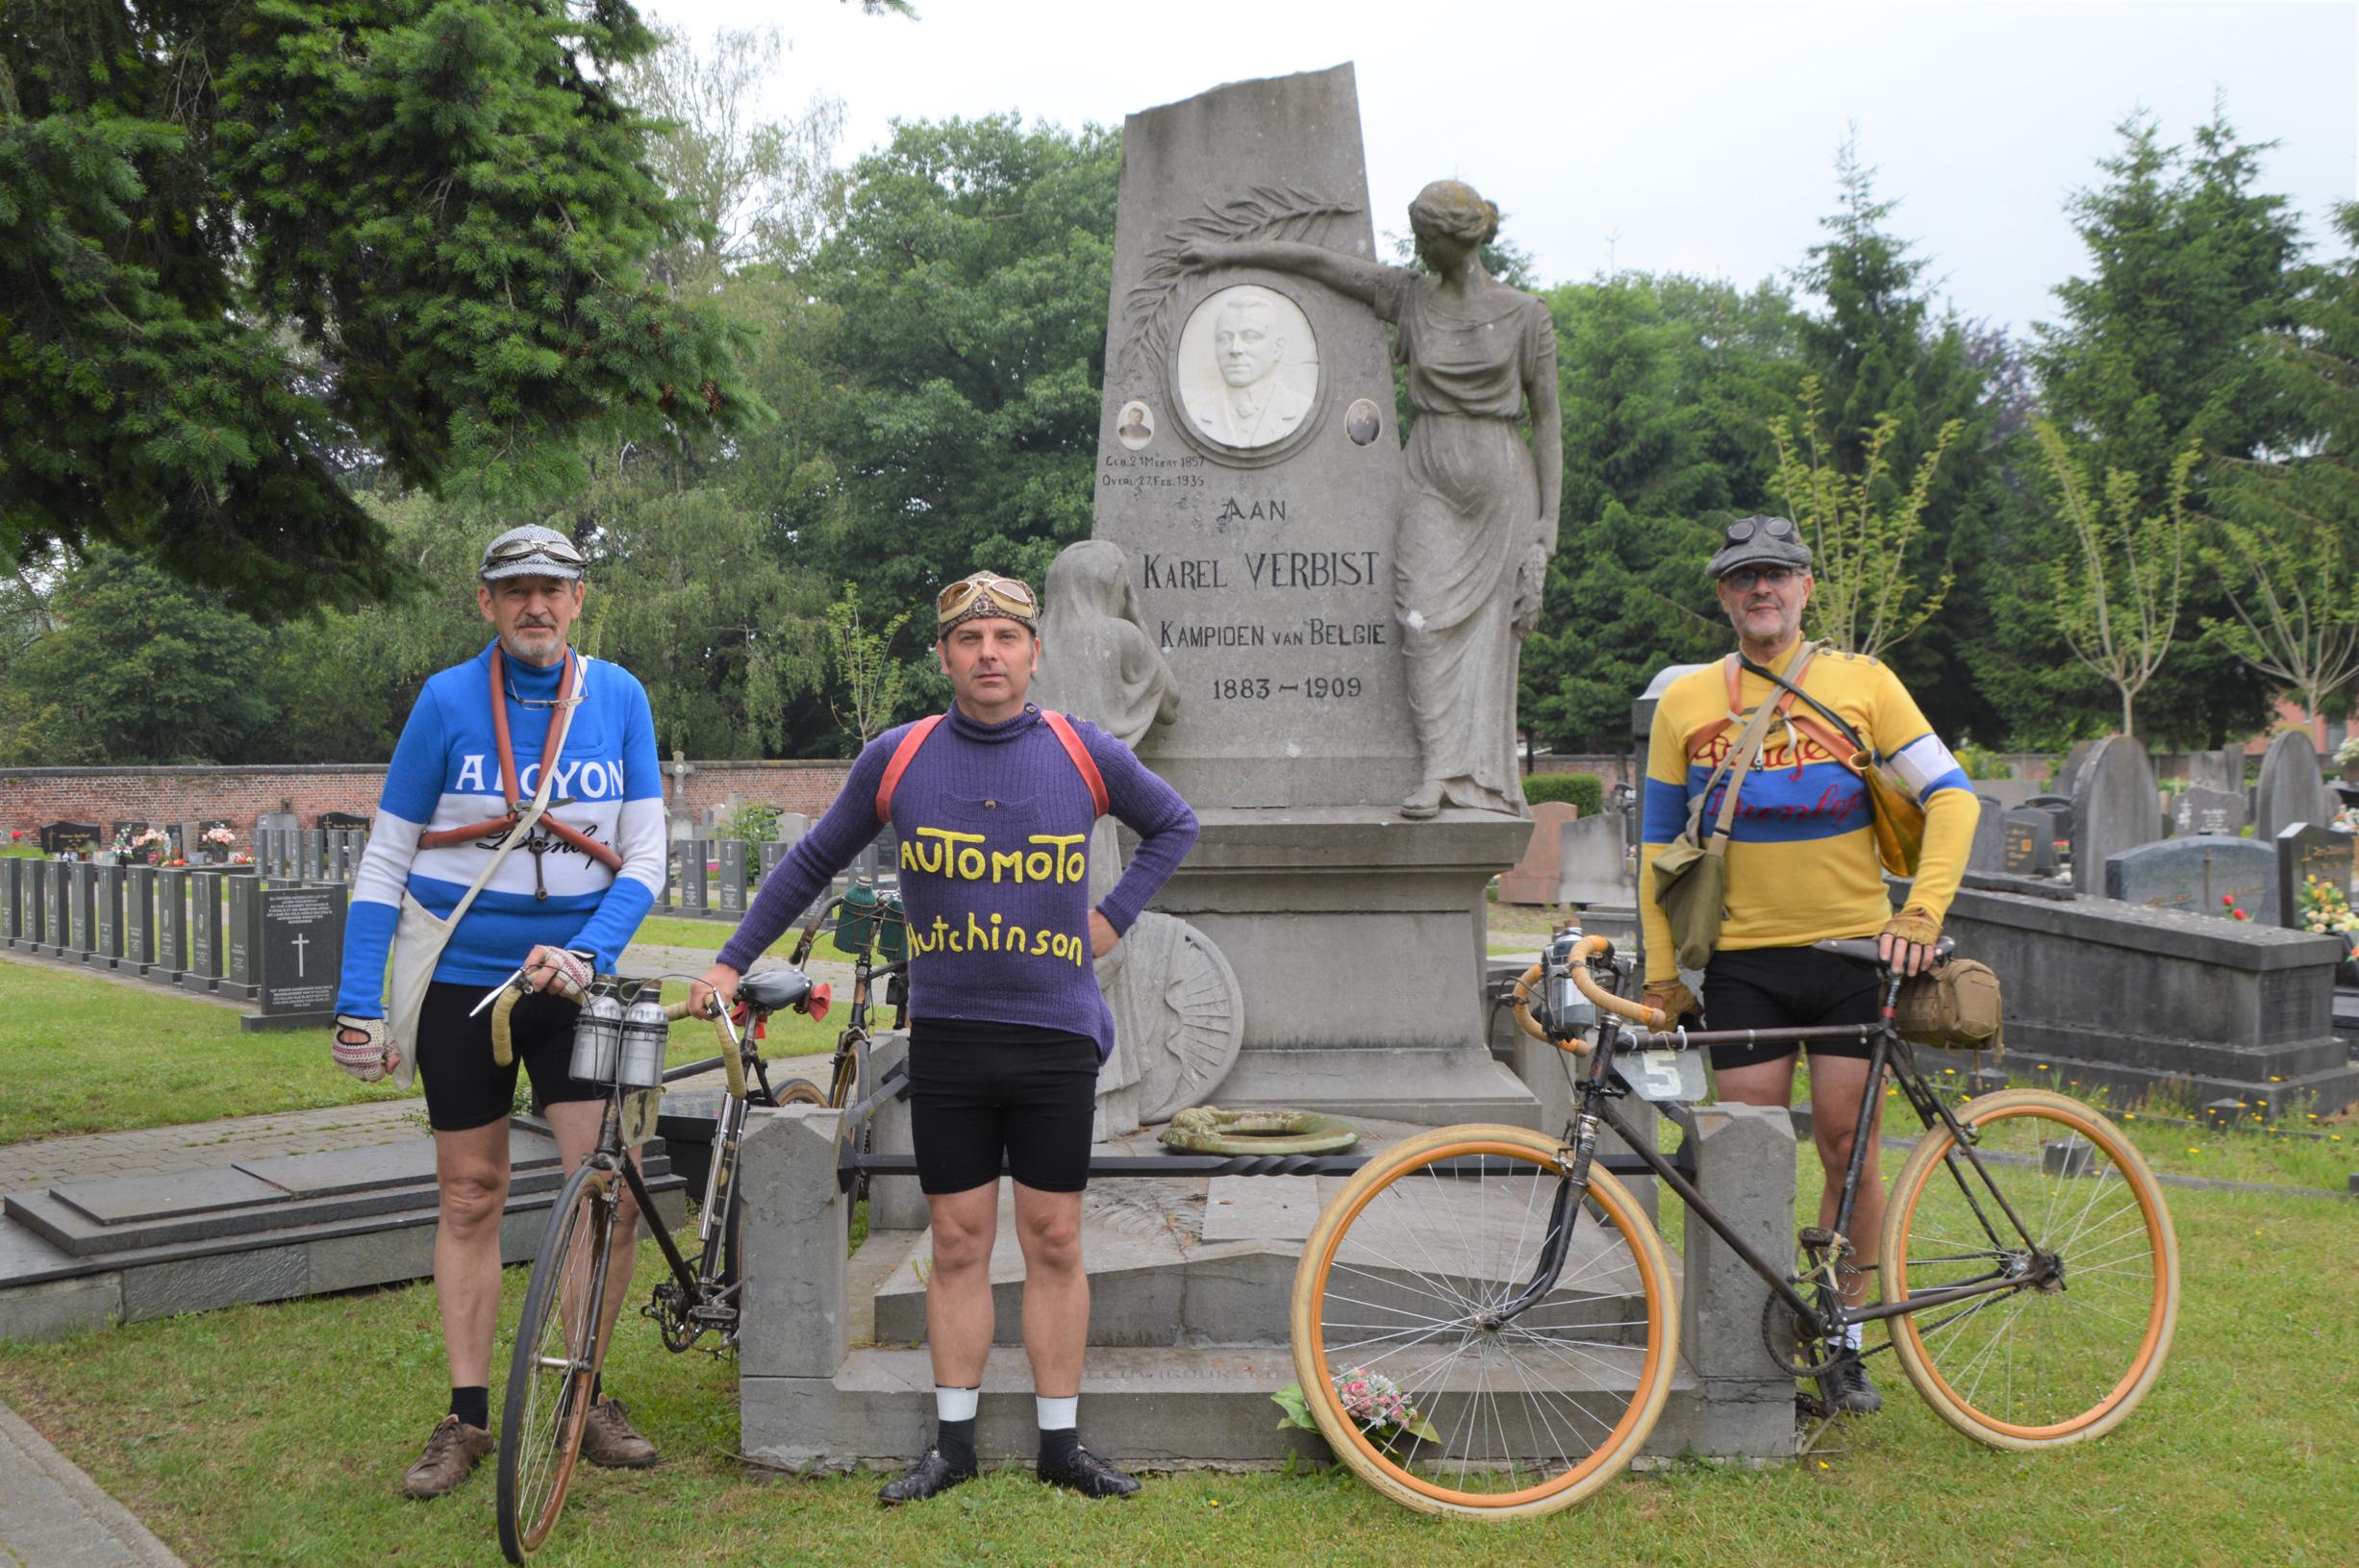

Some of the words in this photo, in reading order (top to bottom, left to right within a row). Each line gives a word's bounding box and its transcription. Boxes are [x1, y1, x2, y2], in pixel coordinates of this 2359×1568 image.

[1223, 497, 1287, 521] AAN
[1142, 553, 1228, 590] KAREL
[1244, 551, 1379, 590] VERBIST
[1160, 620, 1265, 648] KAMPIOEN
[1308, 618, 1387, 647] BELGIE
[1643, 1051, 1682, 1097] 5
